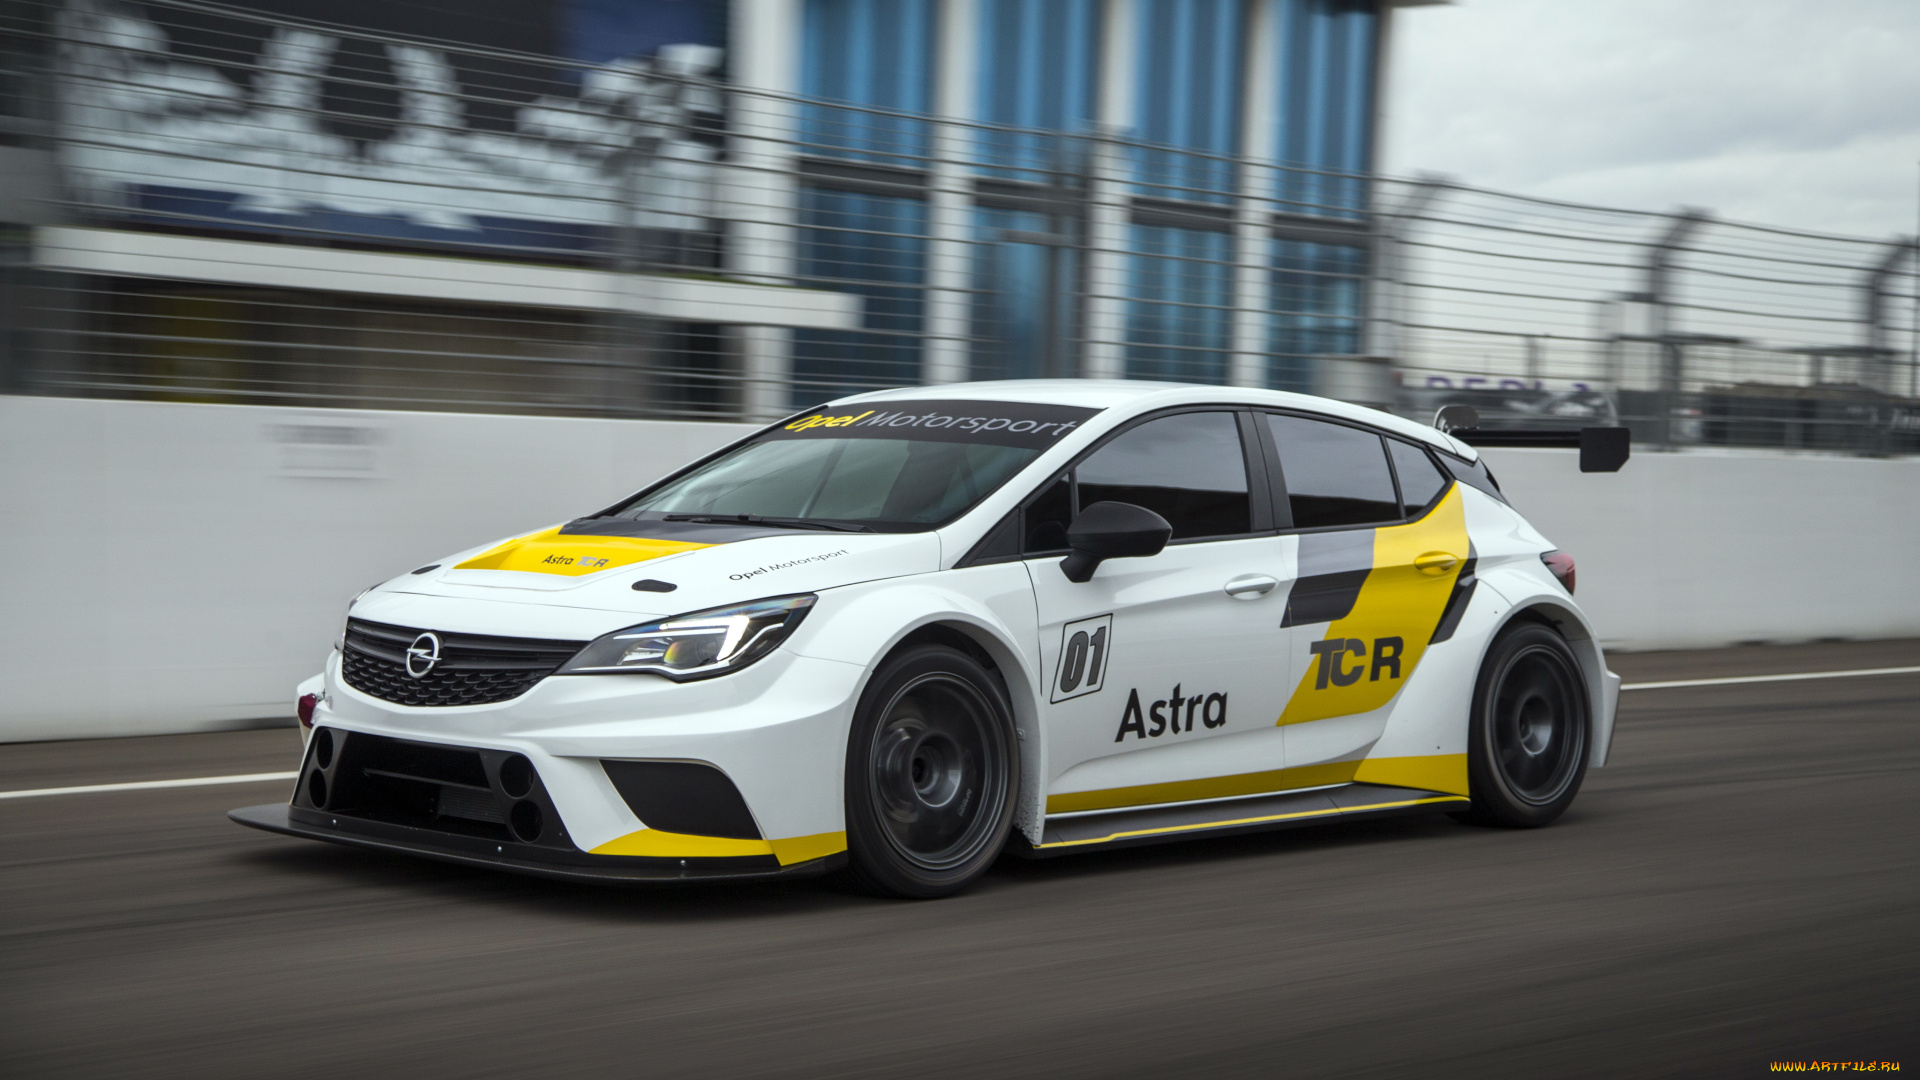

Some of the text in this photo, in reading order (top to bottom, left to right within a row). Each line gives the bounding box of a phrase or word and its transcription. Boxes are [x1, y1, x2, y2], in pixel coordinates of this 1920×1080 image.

[784, 410, 1078, 436] Opel Motorsport
[541, 554, 574, 565] Astra
[729, 549, 849, 581] Opel Motorsport
[1060, 626, 1106, 693] 01
[1114, 682, 1228, 743] Astra
